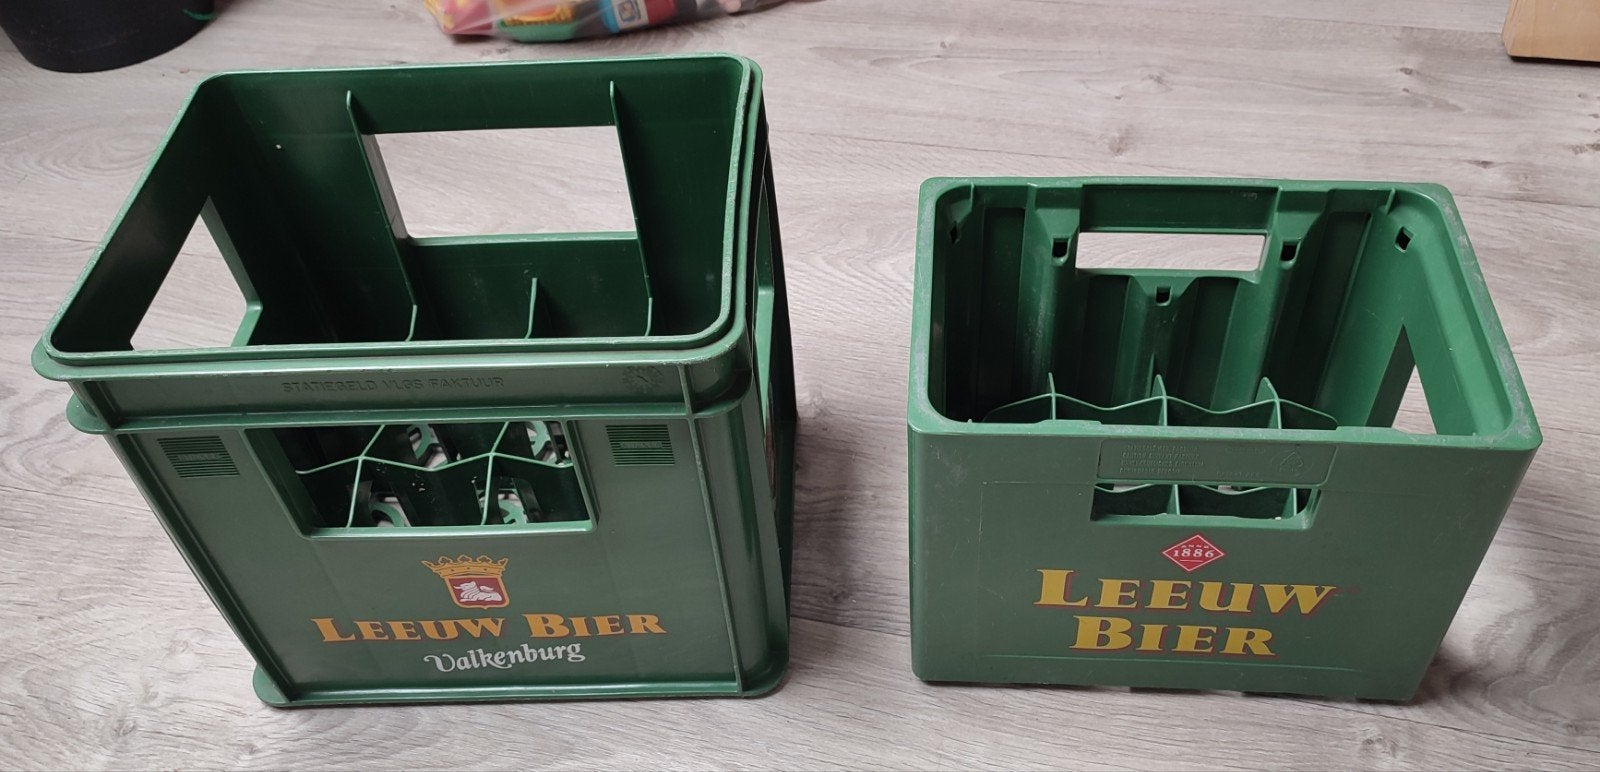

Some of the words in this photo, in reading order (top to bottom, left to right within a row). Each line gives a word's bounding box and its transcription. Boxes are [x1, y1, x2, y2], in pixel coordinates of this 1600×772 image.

[281, 380, 378, 392] STATIEGELD
[382, 379, 422, 390] VLGS
[428, 377, 504, 389] FAKTUUR
[1173, 548, 1215, 558] 1886
[1034, 569, 1336, 614] LEEUW
[311, 617, 504, 642] LEEUW
[522, 613, 667, 638] BIER
[1070, 615, 1276, 656] BIER
[423, 643, 586, 672] Valkenburg
